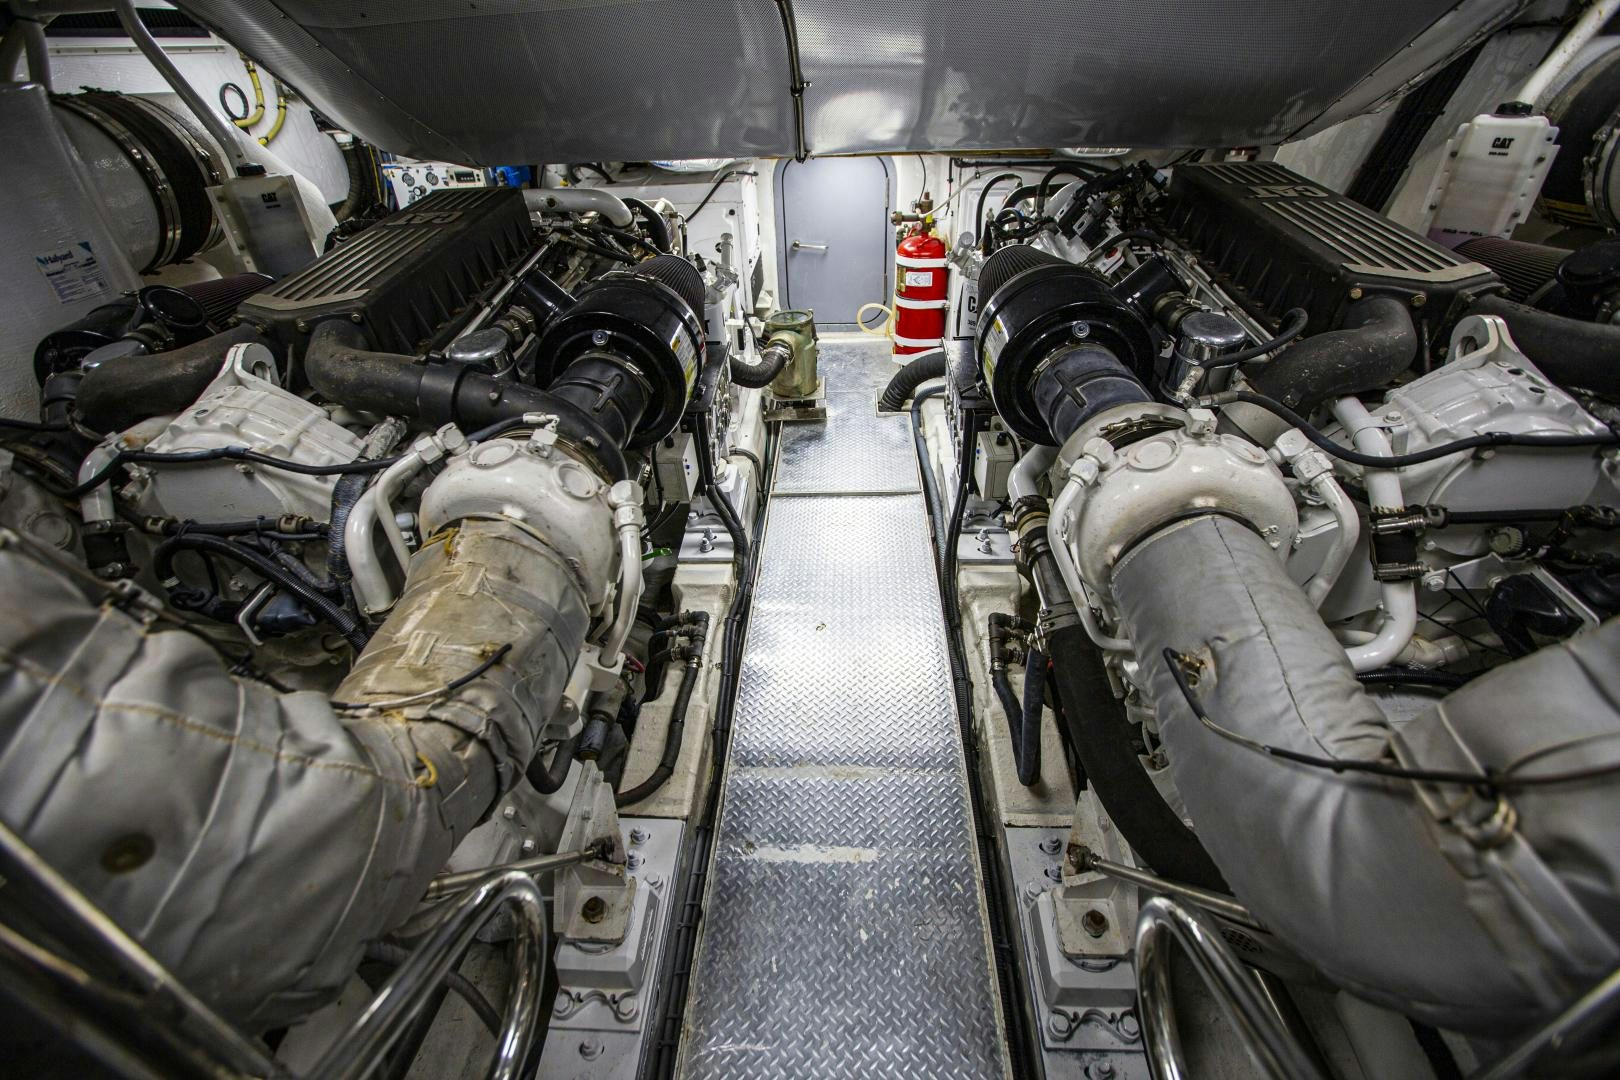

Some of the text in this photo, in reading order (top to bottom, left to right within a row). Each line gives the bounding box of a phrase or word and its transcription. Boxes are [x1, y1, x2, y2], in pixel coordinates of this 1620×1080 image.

[1492, 137, 1515, 149] CAT
[1247, 185, 1329, 198] CAT
[46, 250, 74, 265] Halyard
